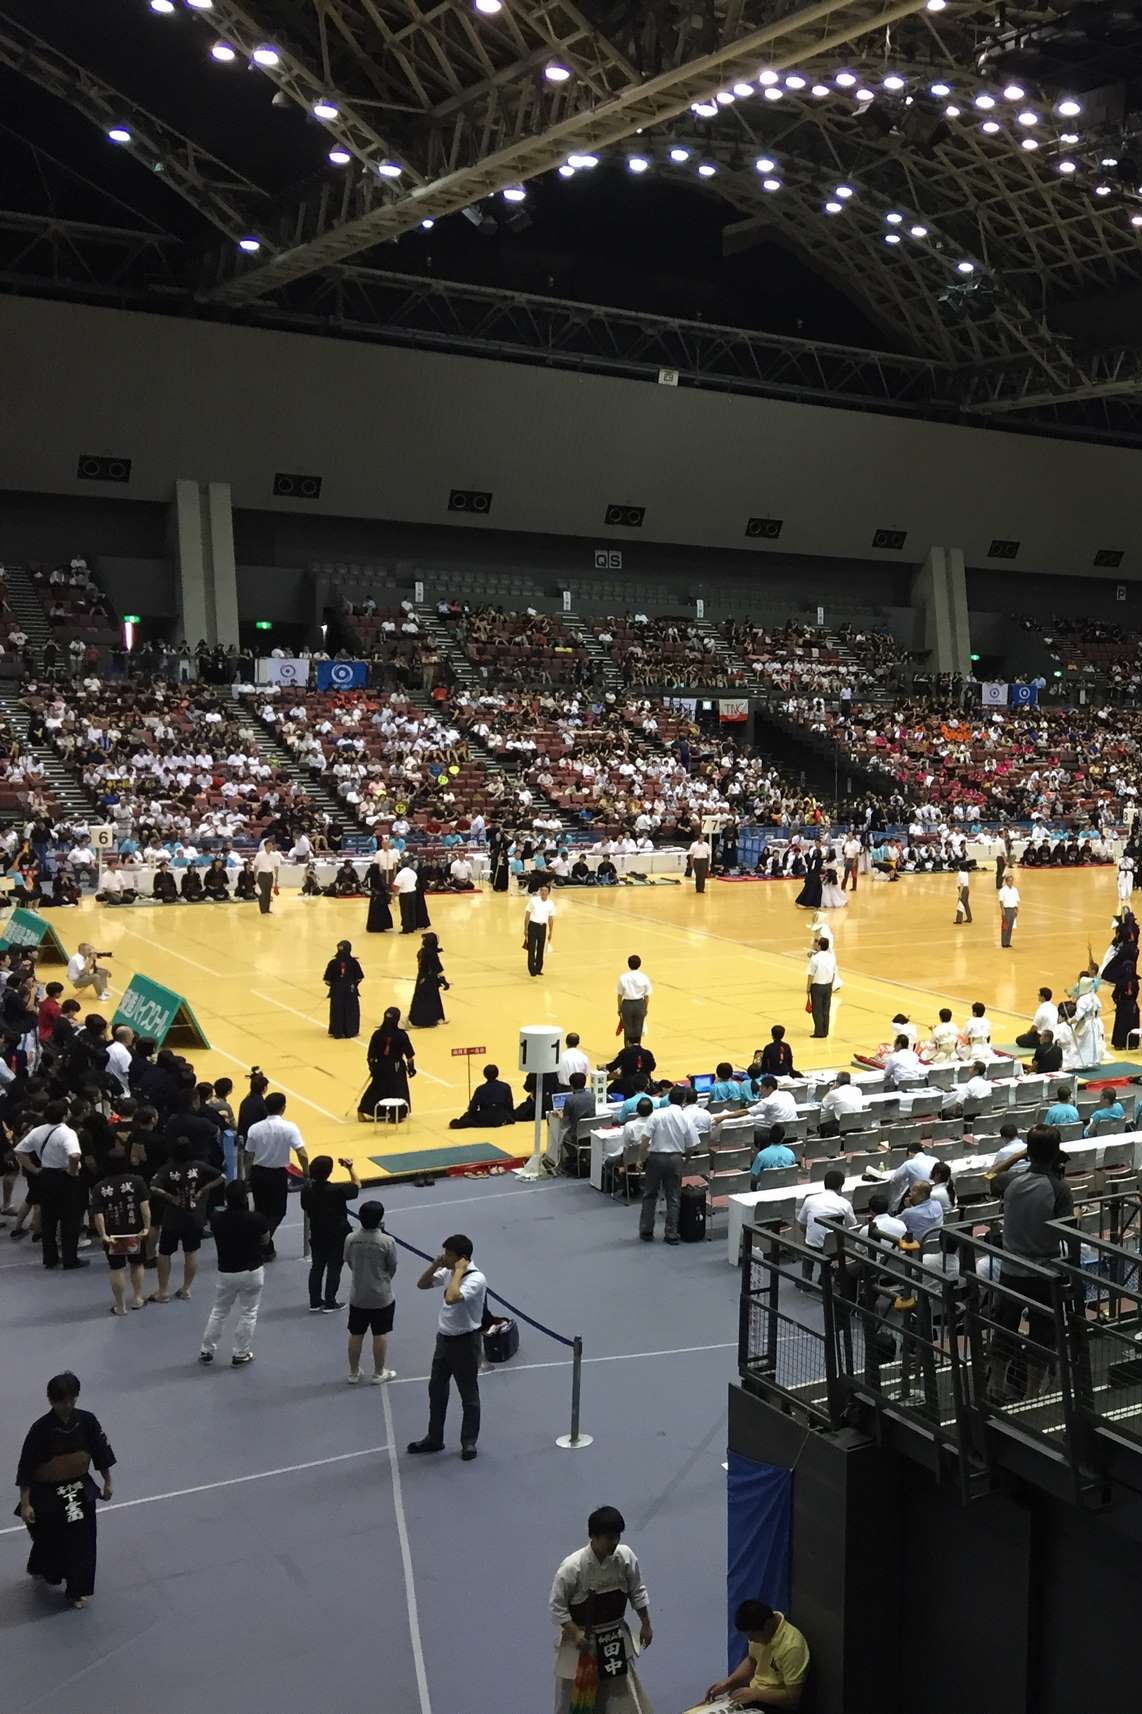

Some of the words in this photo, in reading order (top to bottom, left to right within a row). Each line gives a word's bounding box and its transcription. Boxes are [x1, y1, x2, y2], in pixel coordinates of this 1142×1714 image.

[98, 831, 109, 845] 6
[520, 1039, 527, 1065] 1
[551, 1039, 560, 1065] 1
[604, 1642, 622, 1675] 田中
